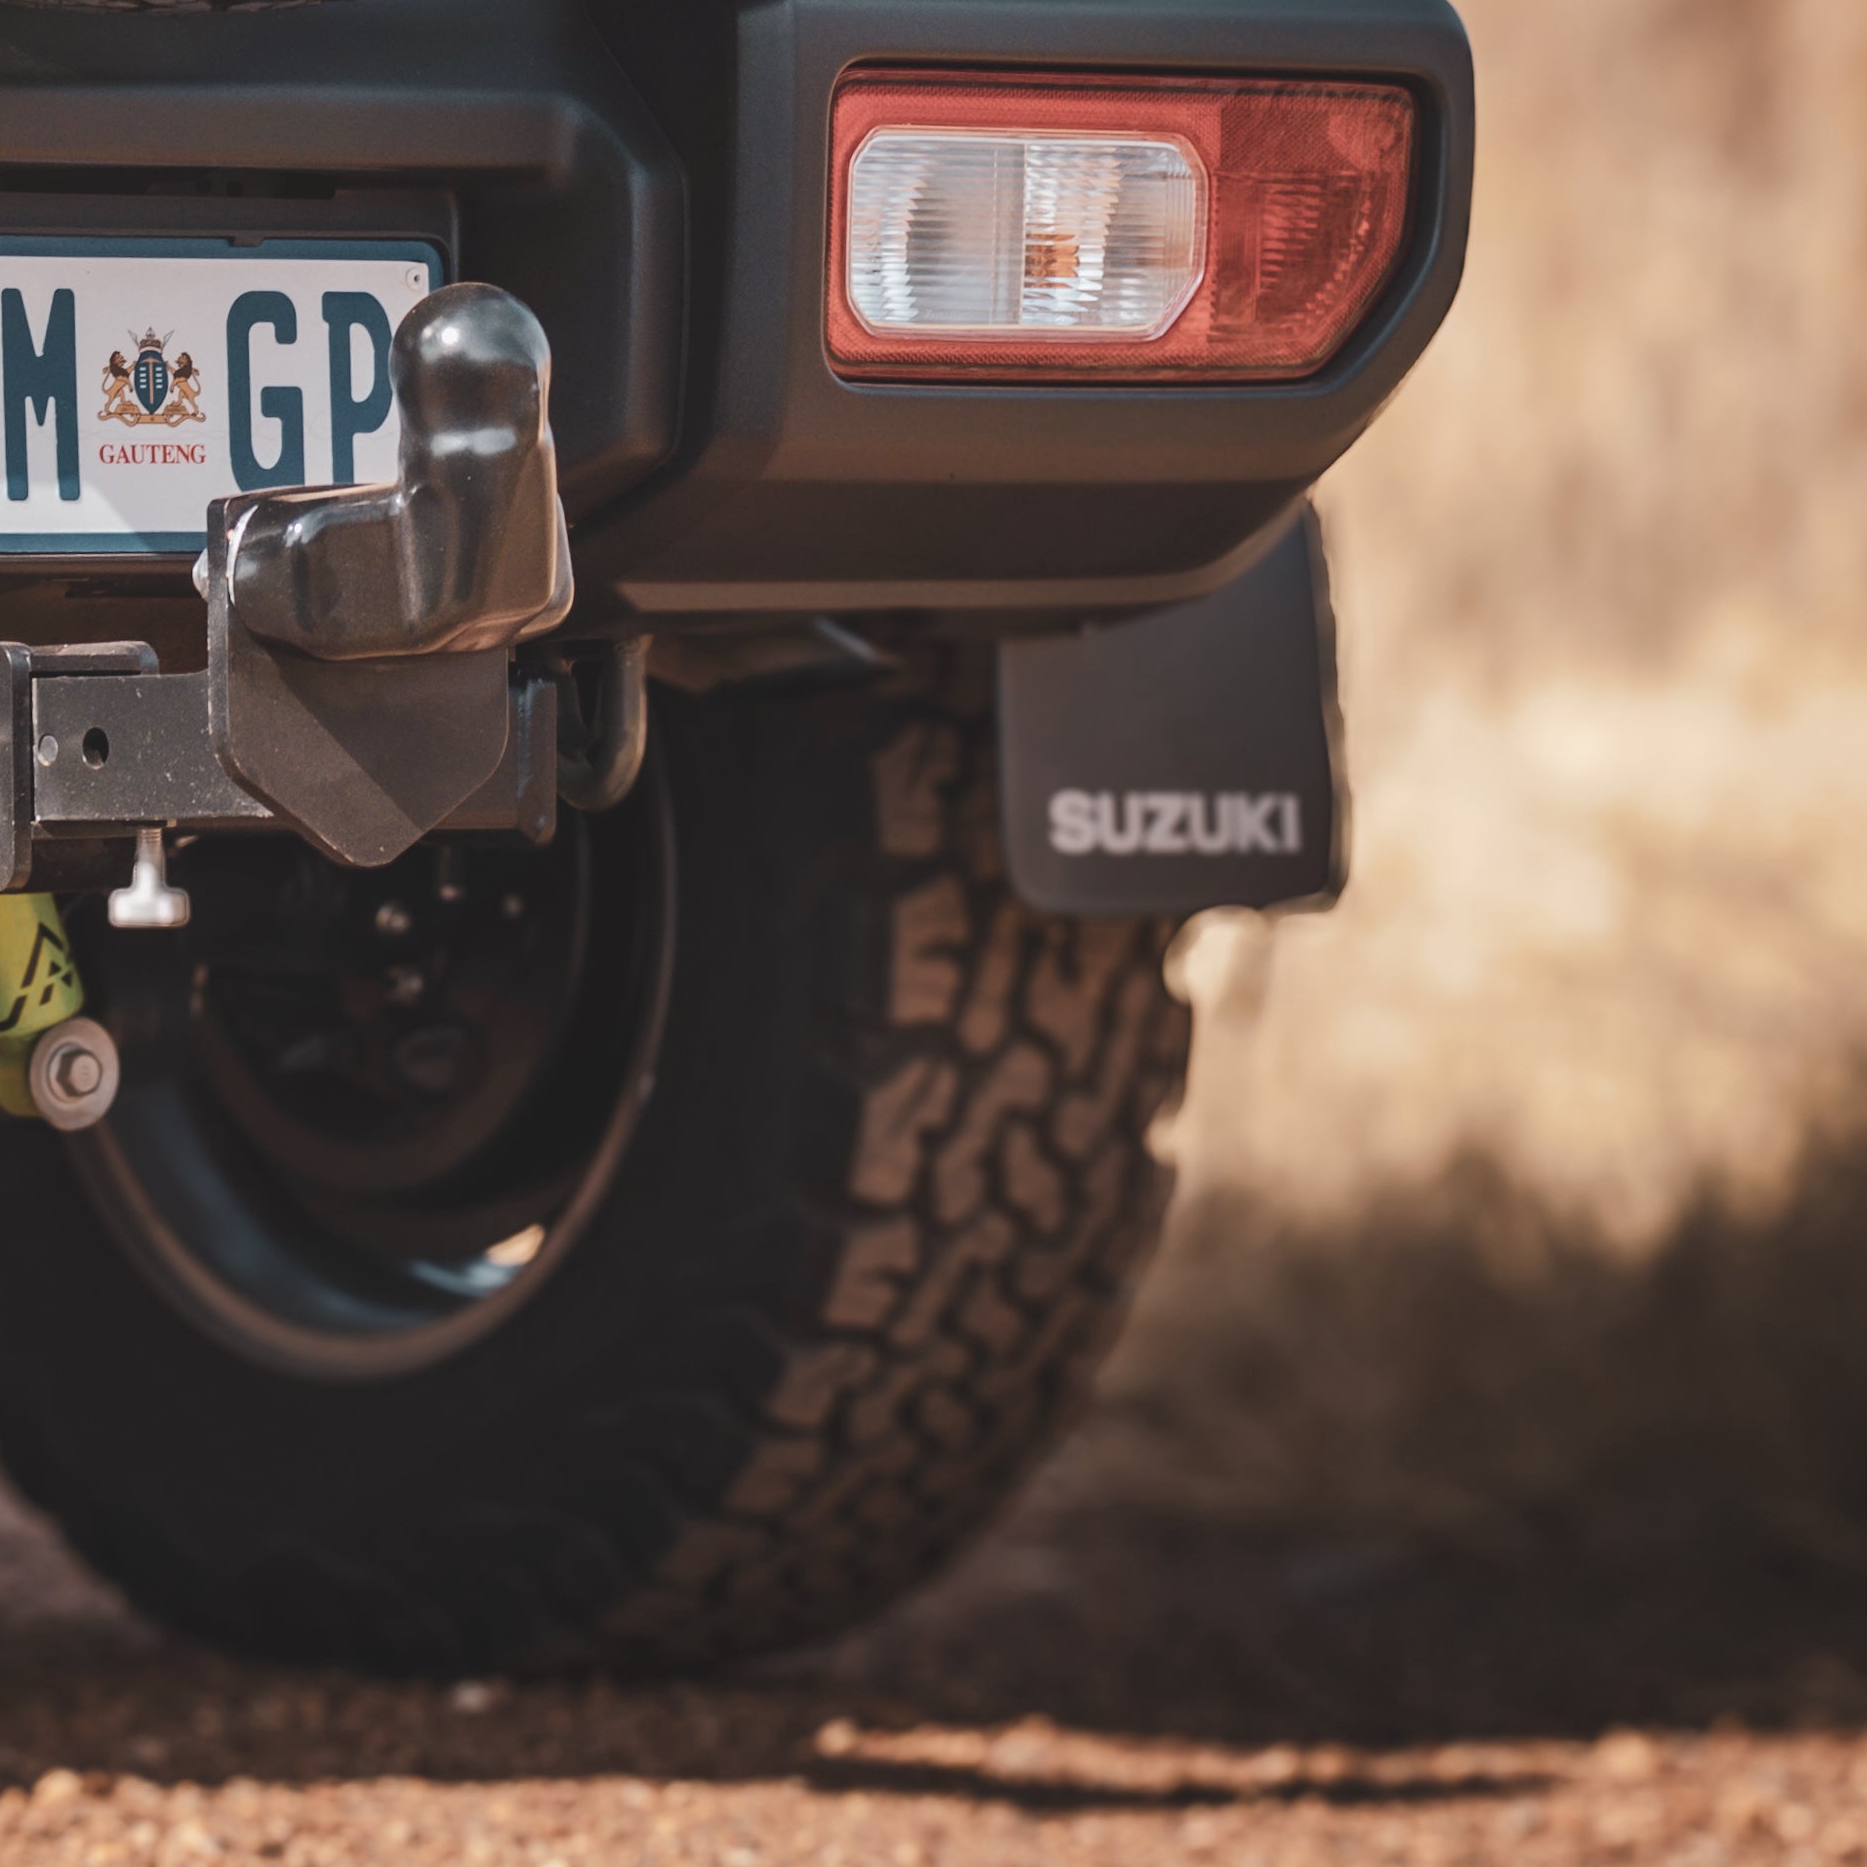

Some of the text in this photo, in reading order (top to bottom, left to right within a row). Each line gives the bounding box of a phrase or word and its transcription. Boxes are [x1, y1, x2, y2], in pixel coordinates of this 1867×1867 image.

[226, 290, 394, 494] GP
[98, 443, 207, 465] GAUTENG
[1047, 787, 1304, 856] SUZUKI
